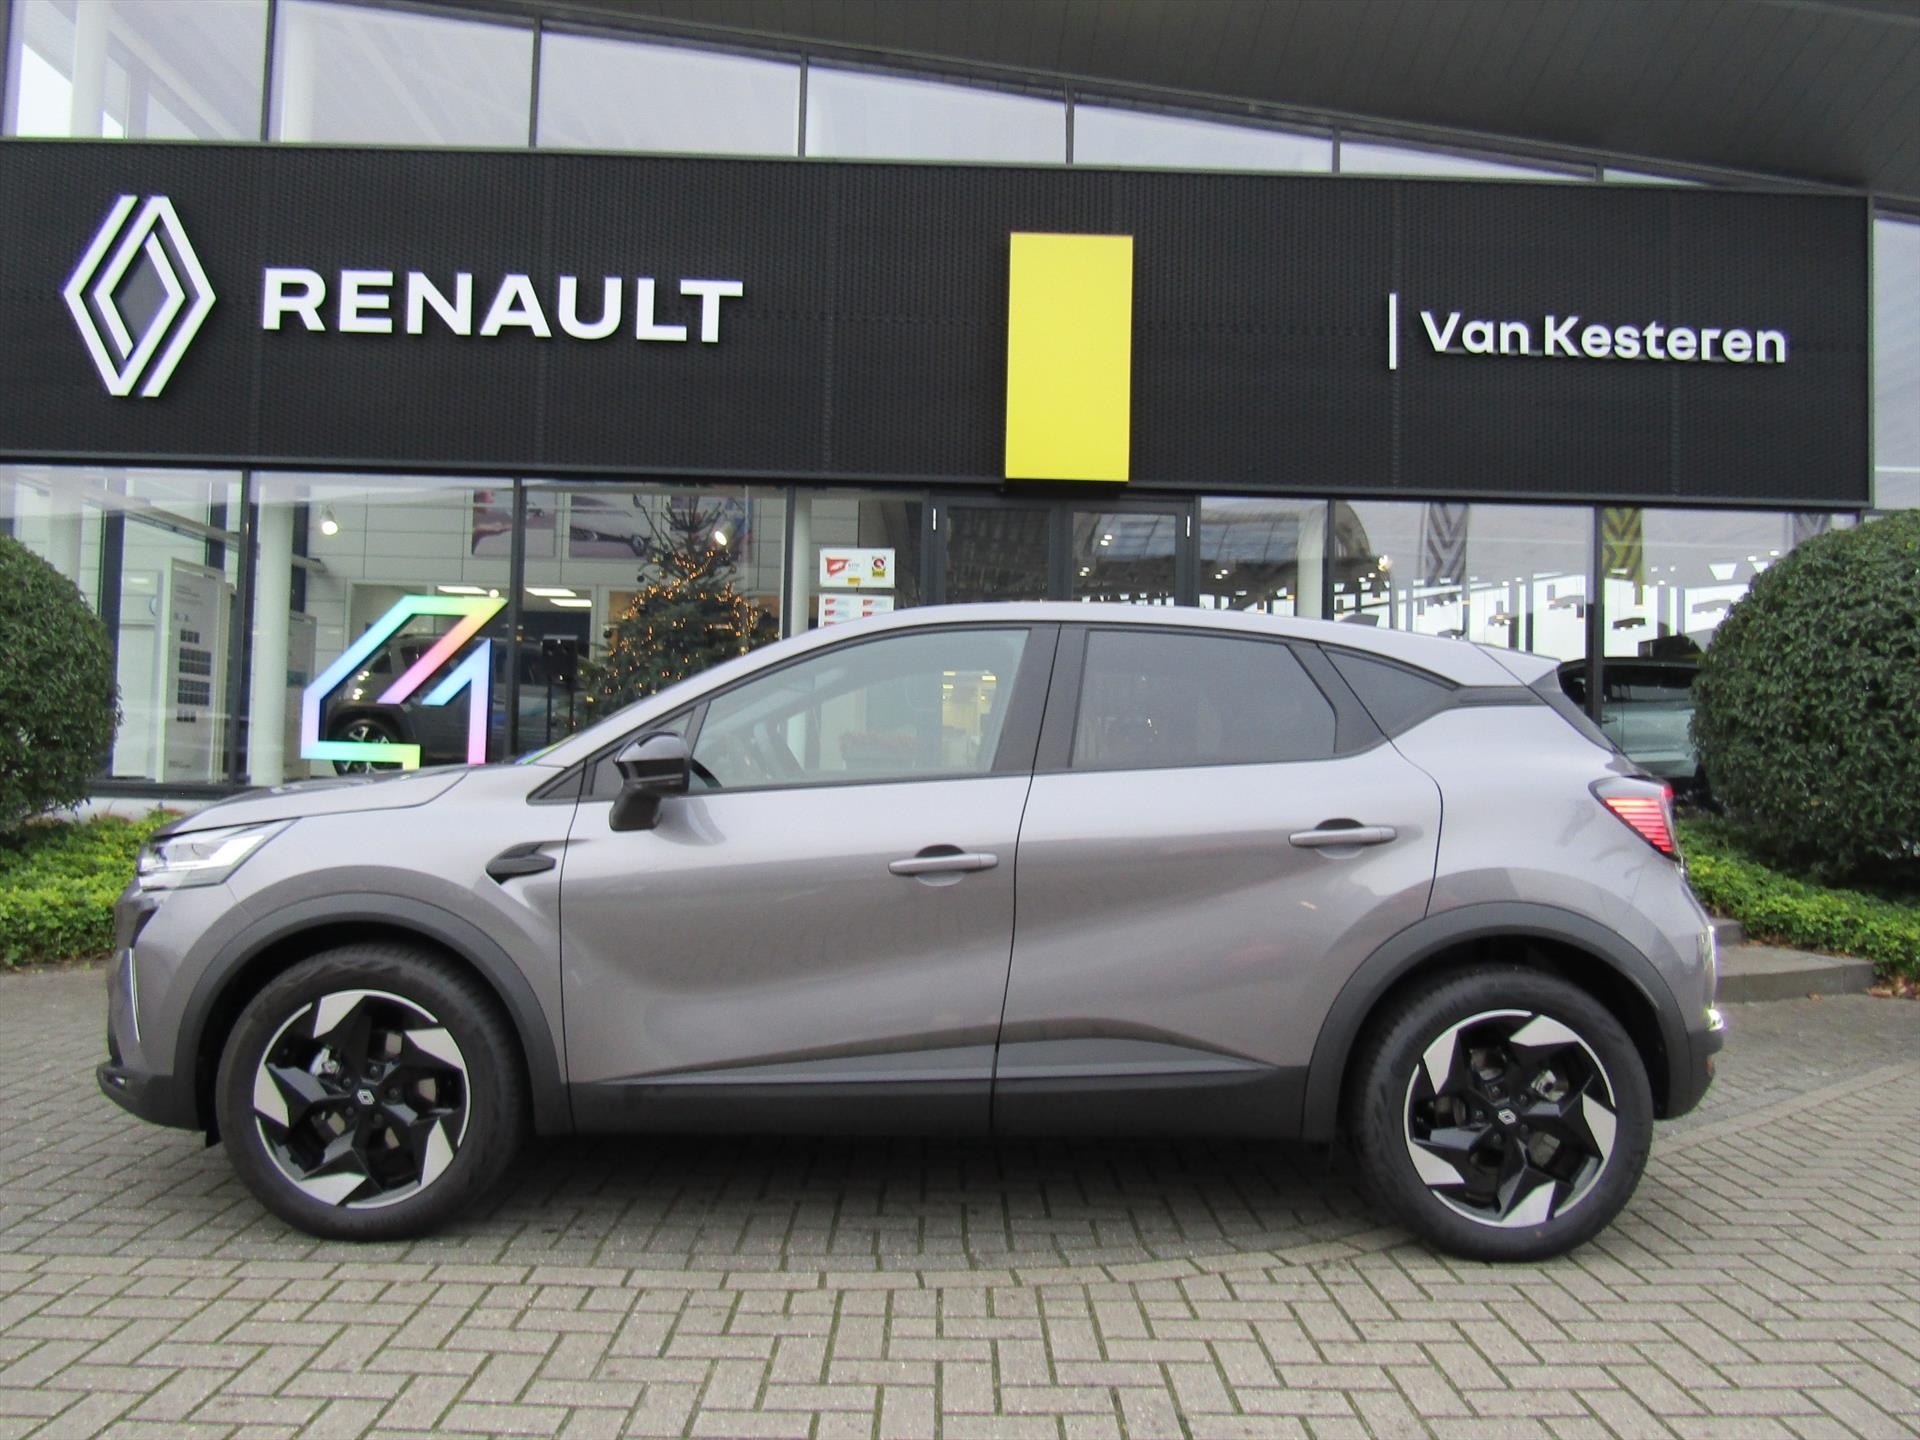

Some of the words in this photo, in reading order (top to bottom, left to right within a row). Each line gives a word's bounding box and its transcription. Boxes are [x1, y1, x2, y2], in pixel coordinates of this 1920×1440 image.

[262, 267, 744, 343] RENAULT
[1420, 311, 1530, 355] Van
[1544, 315, 1786, 363] Kesteren
